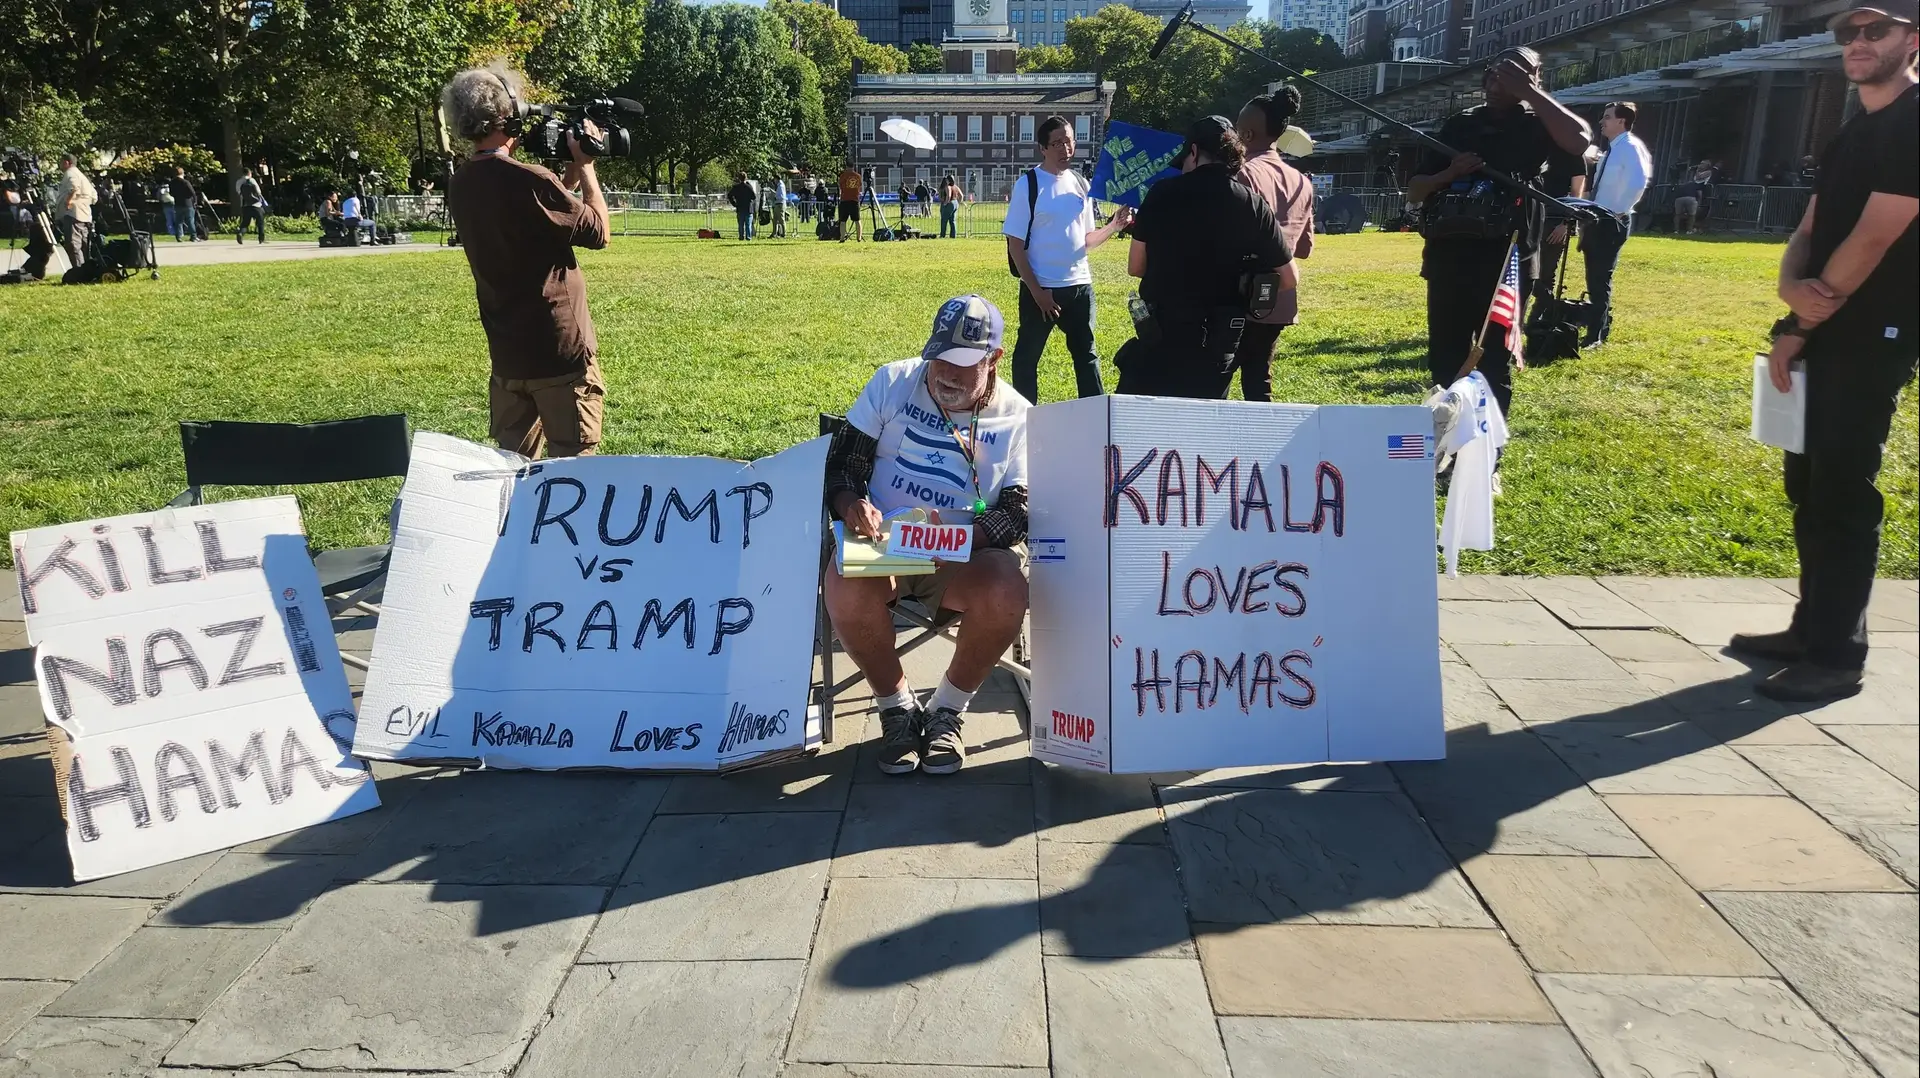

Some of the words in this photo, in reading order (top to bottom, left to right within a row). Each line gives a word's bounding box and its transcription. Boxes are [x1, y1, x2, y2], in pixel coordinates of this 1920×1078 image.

[1104, 135, 1134, 160] WE
[1113, 149, 1150, 182] ARE
[901, 402, 946, 432] NEVER
[453, 463, 774, 549] TRUMP
[891, 474, 904, 490] IS
[906, 481, 955, 509] NOW!
[1103, 443, 1346, 538] KAMALA
[901, 524, 967, 552] TRUMP
[1156, 550, 1310, 618] LOVES
[610, 709, 703, 754] LOVES
[718, 701, 790, 754] HAMAS
[1052, 710, 1095, 743] TRUMP
[68, 707, 373, 843] HAMAS
